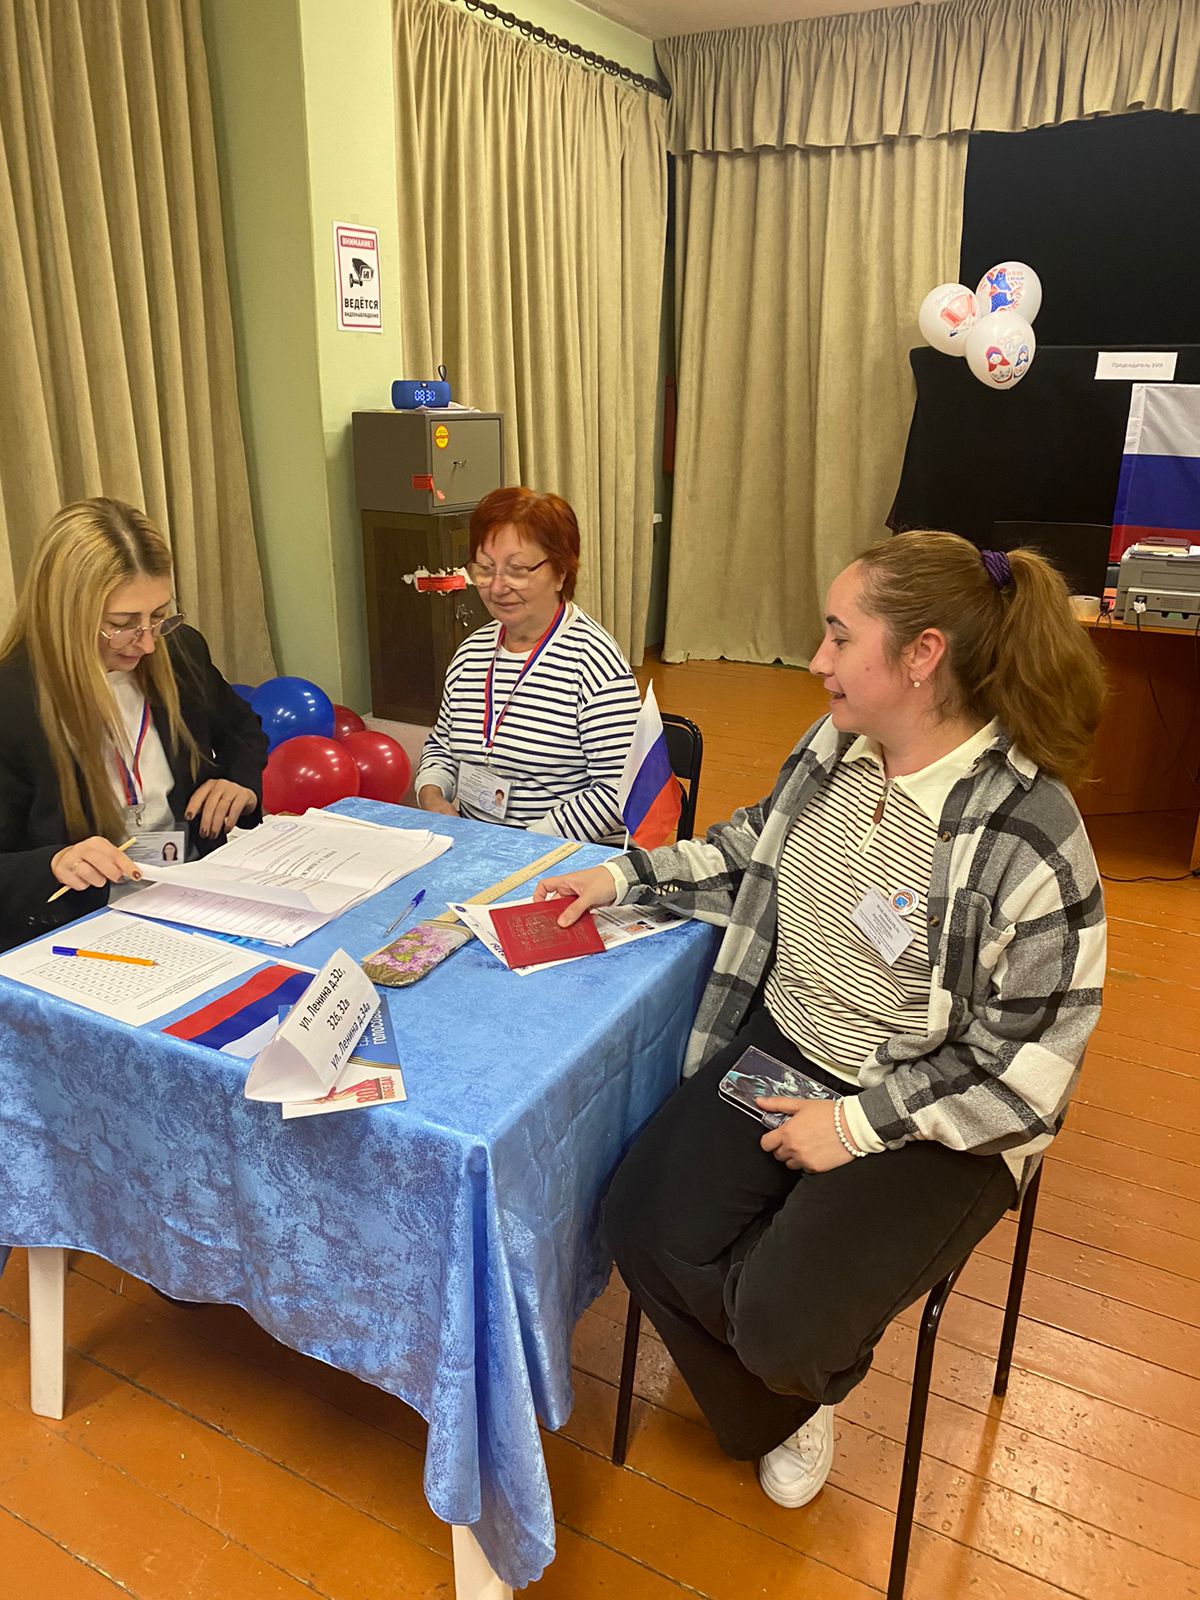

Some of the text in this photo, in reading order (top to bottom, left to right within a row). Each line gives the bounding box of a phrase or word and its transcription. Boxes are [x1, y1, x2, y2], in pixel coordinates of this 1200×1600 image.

[344, 296, 379, 310] ВЕДЁТСЯ
[299, 1016, 313, 1031] ул.
[306, 985, 332, 1017] Ленина
[338, 1021, 359, 1054] Ленина
